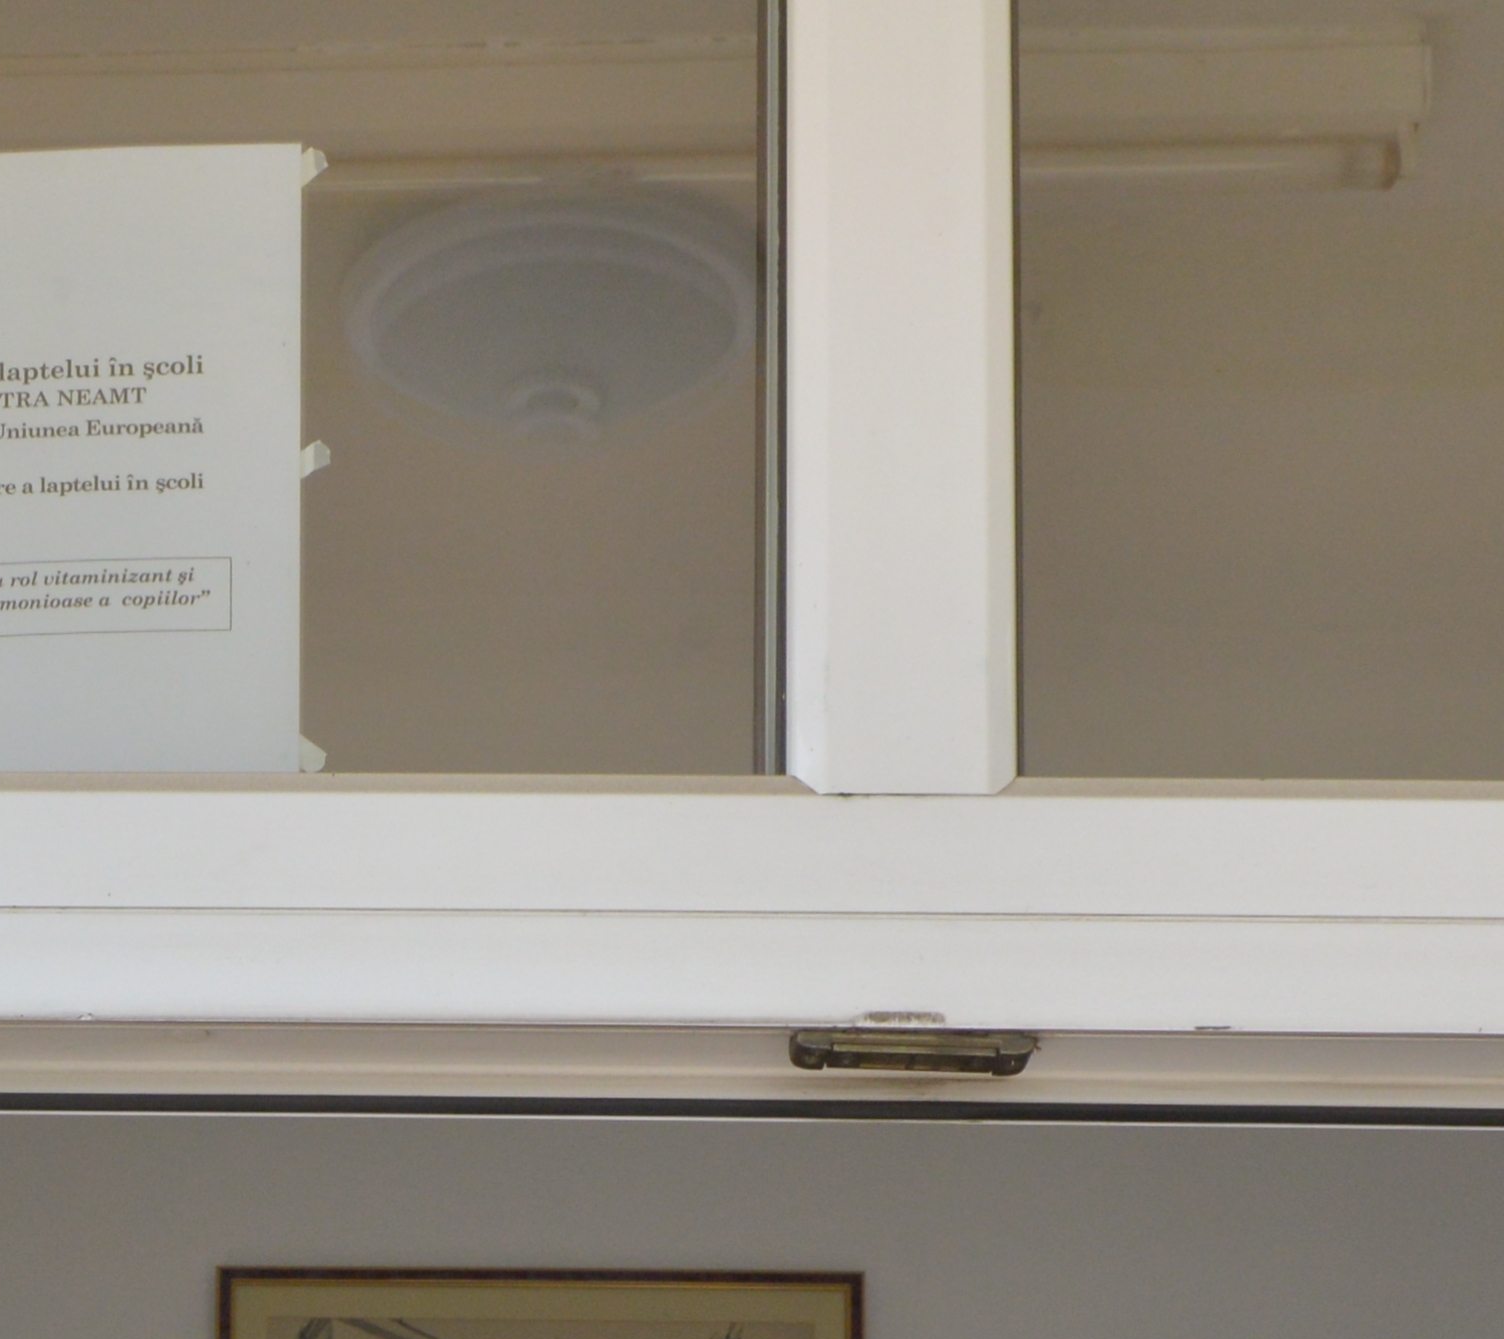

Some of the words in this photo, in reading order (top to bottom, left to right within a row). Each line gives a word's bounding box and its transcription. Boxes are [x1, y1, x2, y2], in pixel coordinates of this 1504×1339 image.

[108, 357, 134, 377] în
[56, 387, 147, 407] NEAMT
[85, 417, 204, 439] Europeană
[21, 480, 34, 494] a
[39, 475, 120, 497] laptelui
[126, 474, 149, 491] în
[9, 570, 37, 587] rol
[43, 568, 172, 587] vitaminizant
[98, 596, 110, 608] a
